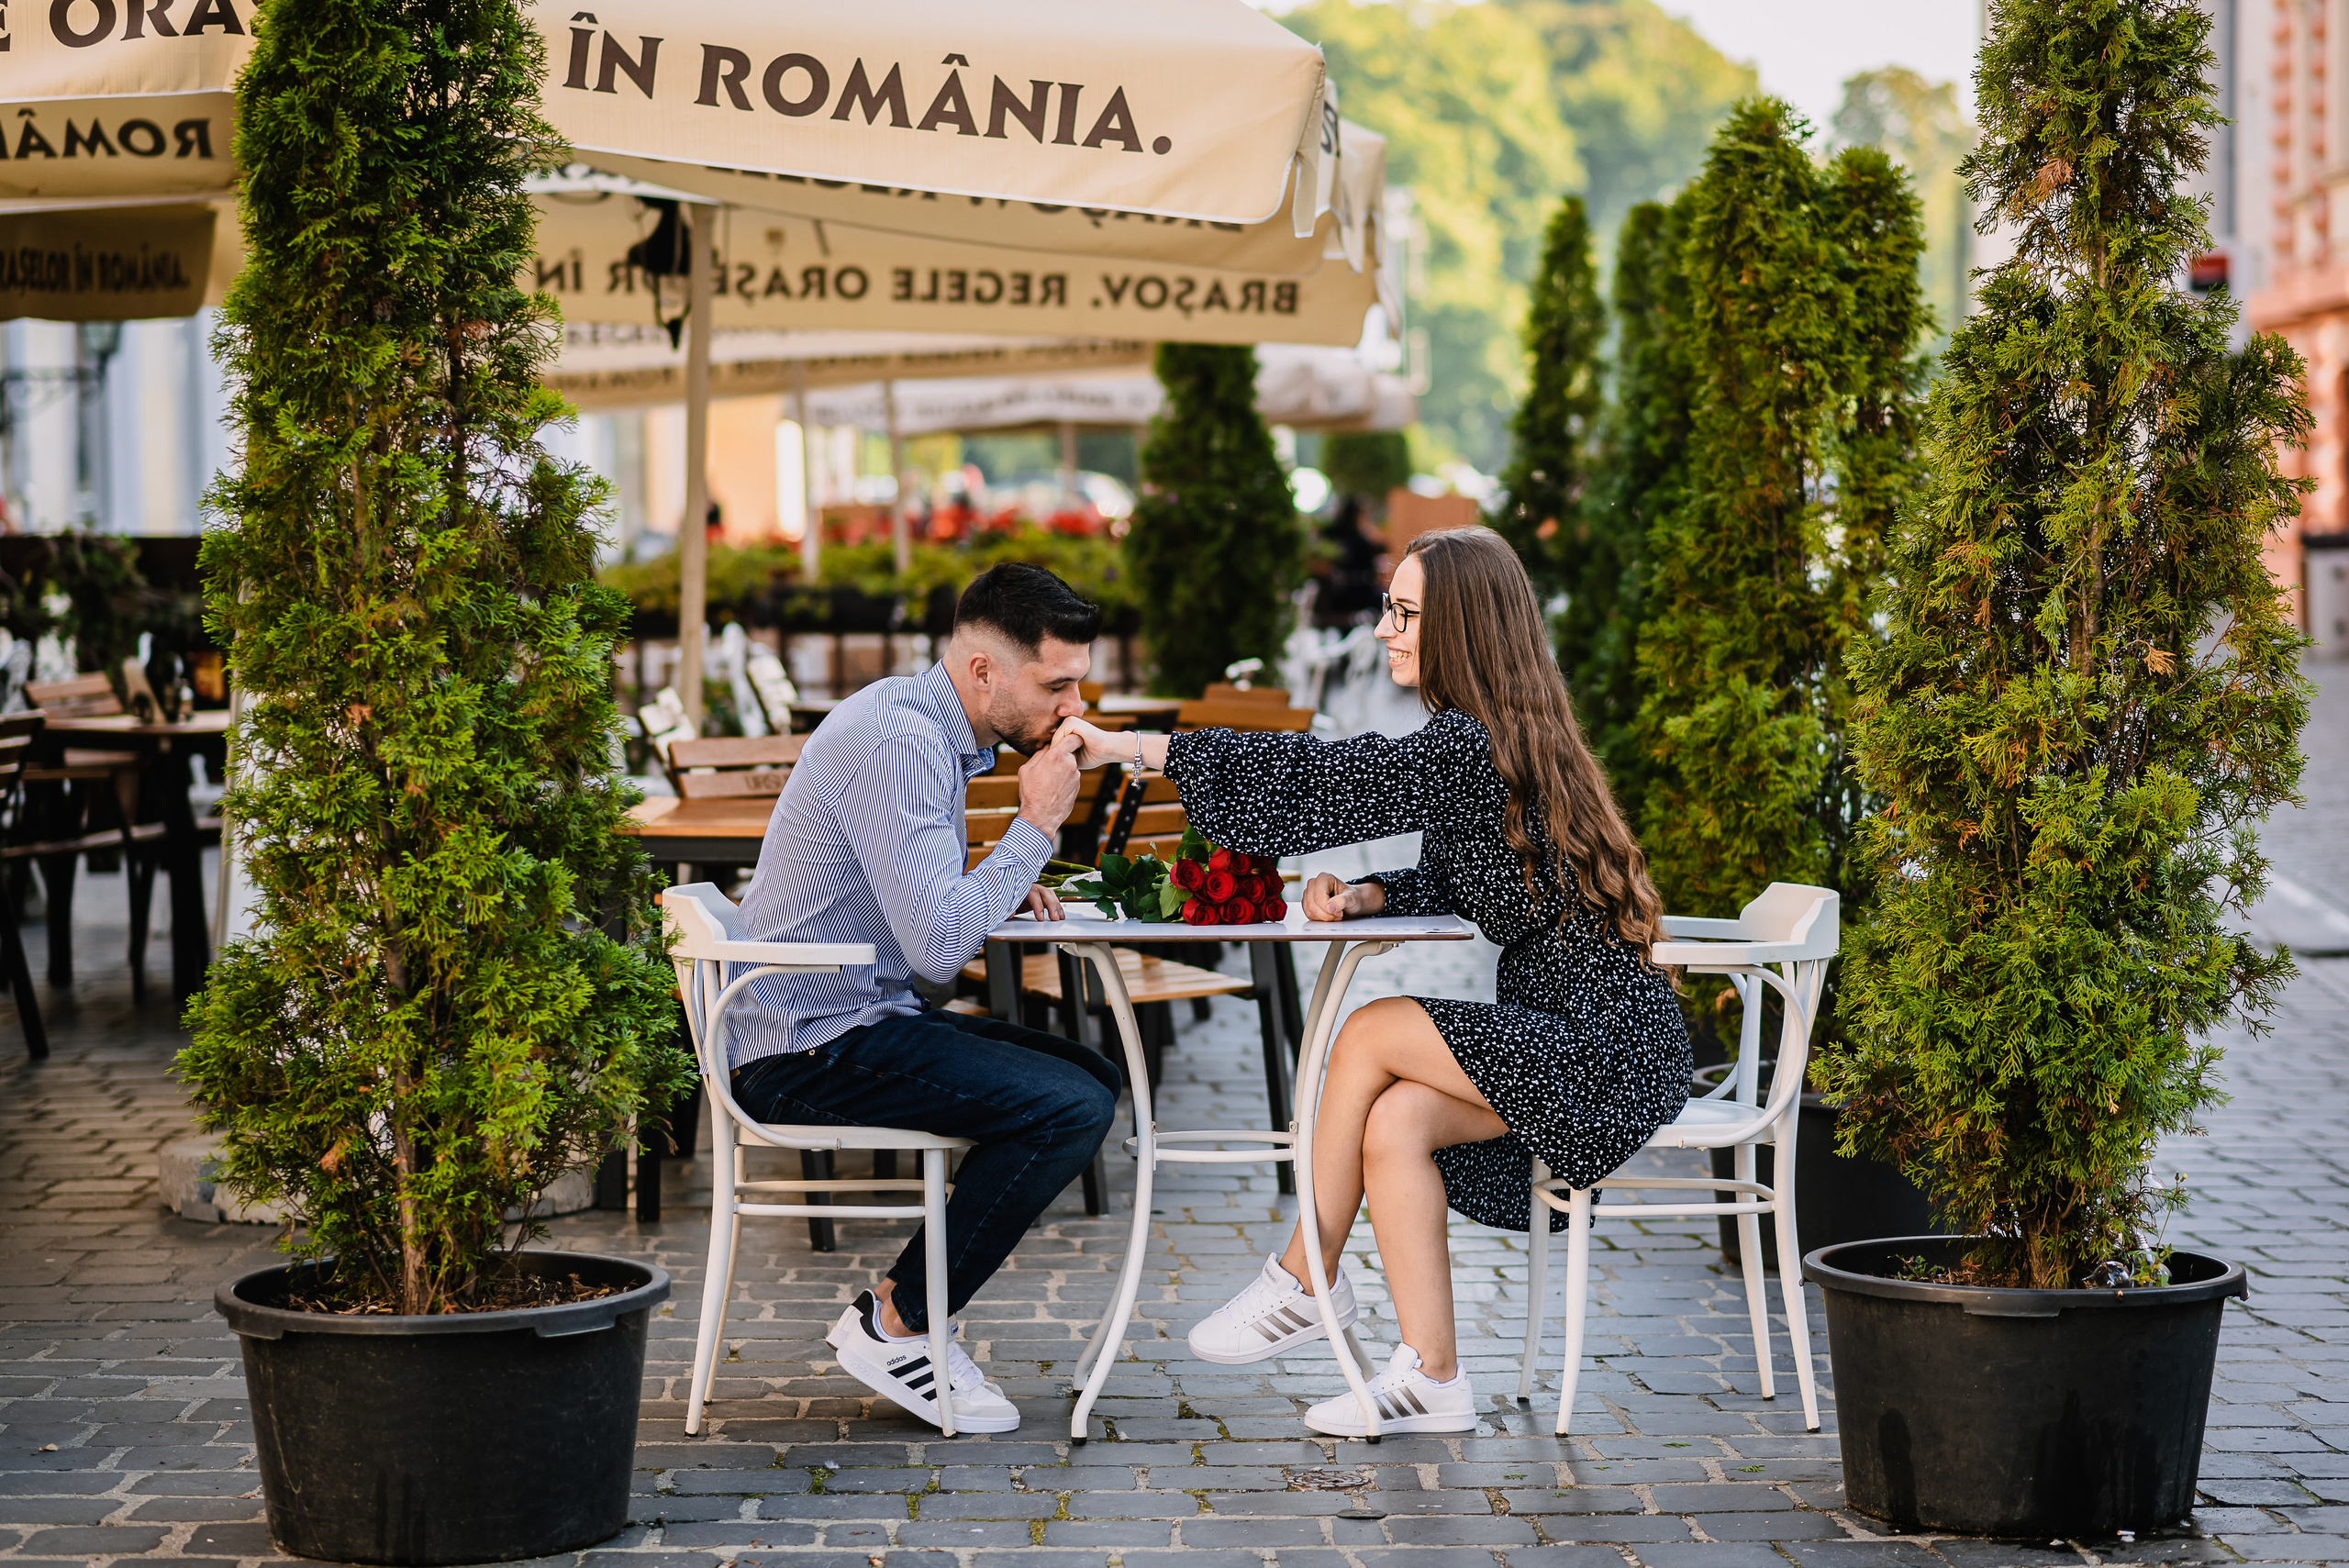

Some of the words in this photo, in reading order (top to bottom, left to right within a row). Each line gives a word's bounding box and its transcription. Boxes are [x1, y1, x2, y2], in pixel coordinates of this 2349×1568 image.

[562, 11, 663, 99] ÎN
[694, 43, 1172, 155] ROMÂNIA.
[886, 1354, 907, 1366] adidas
